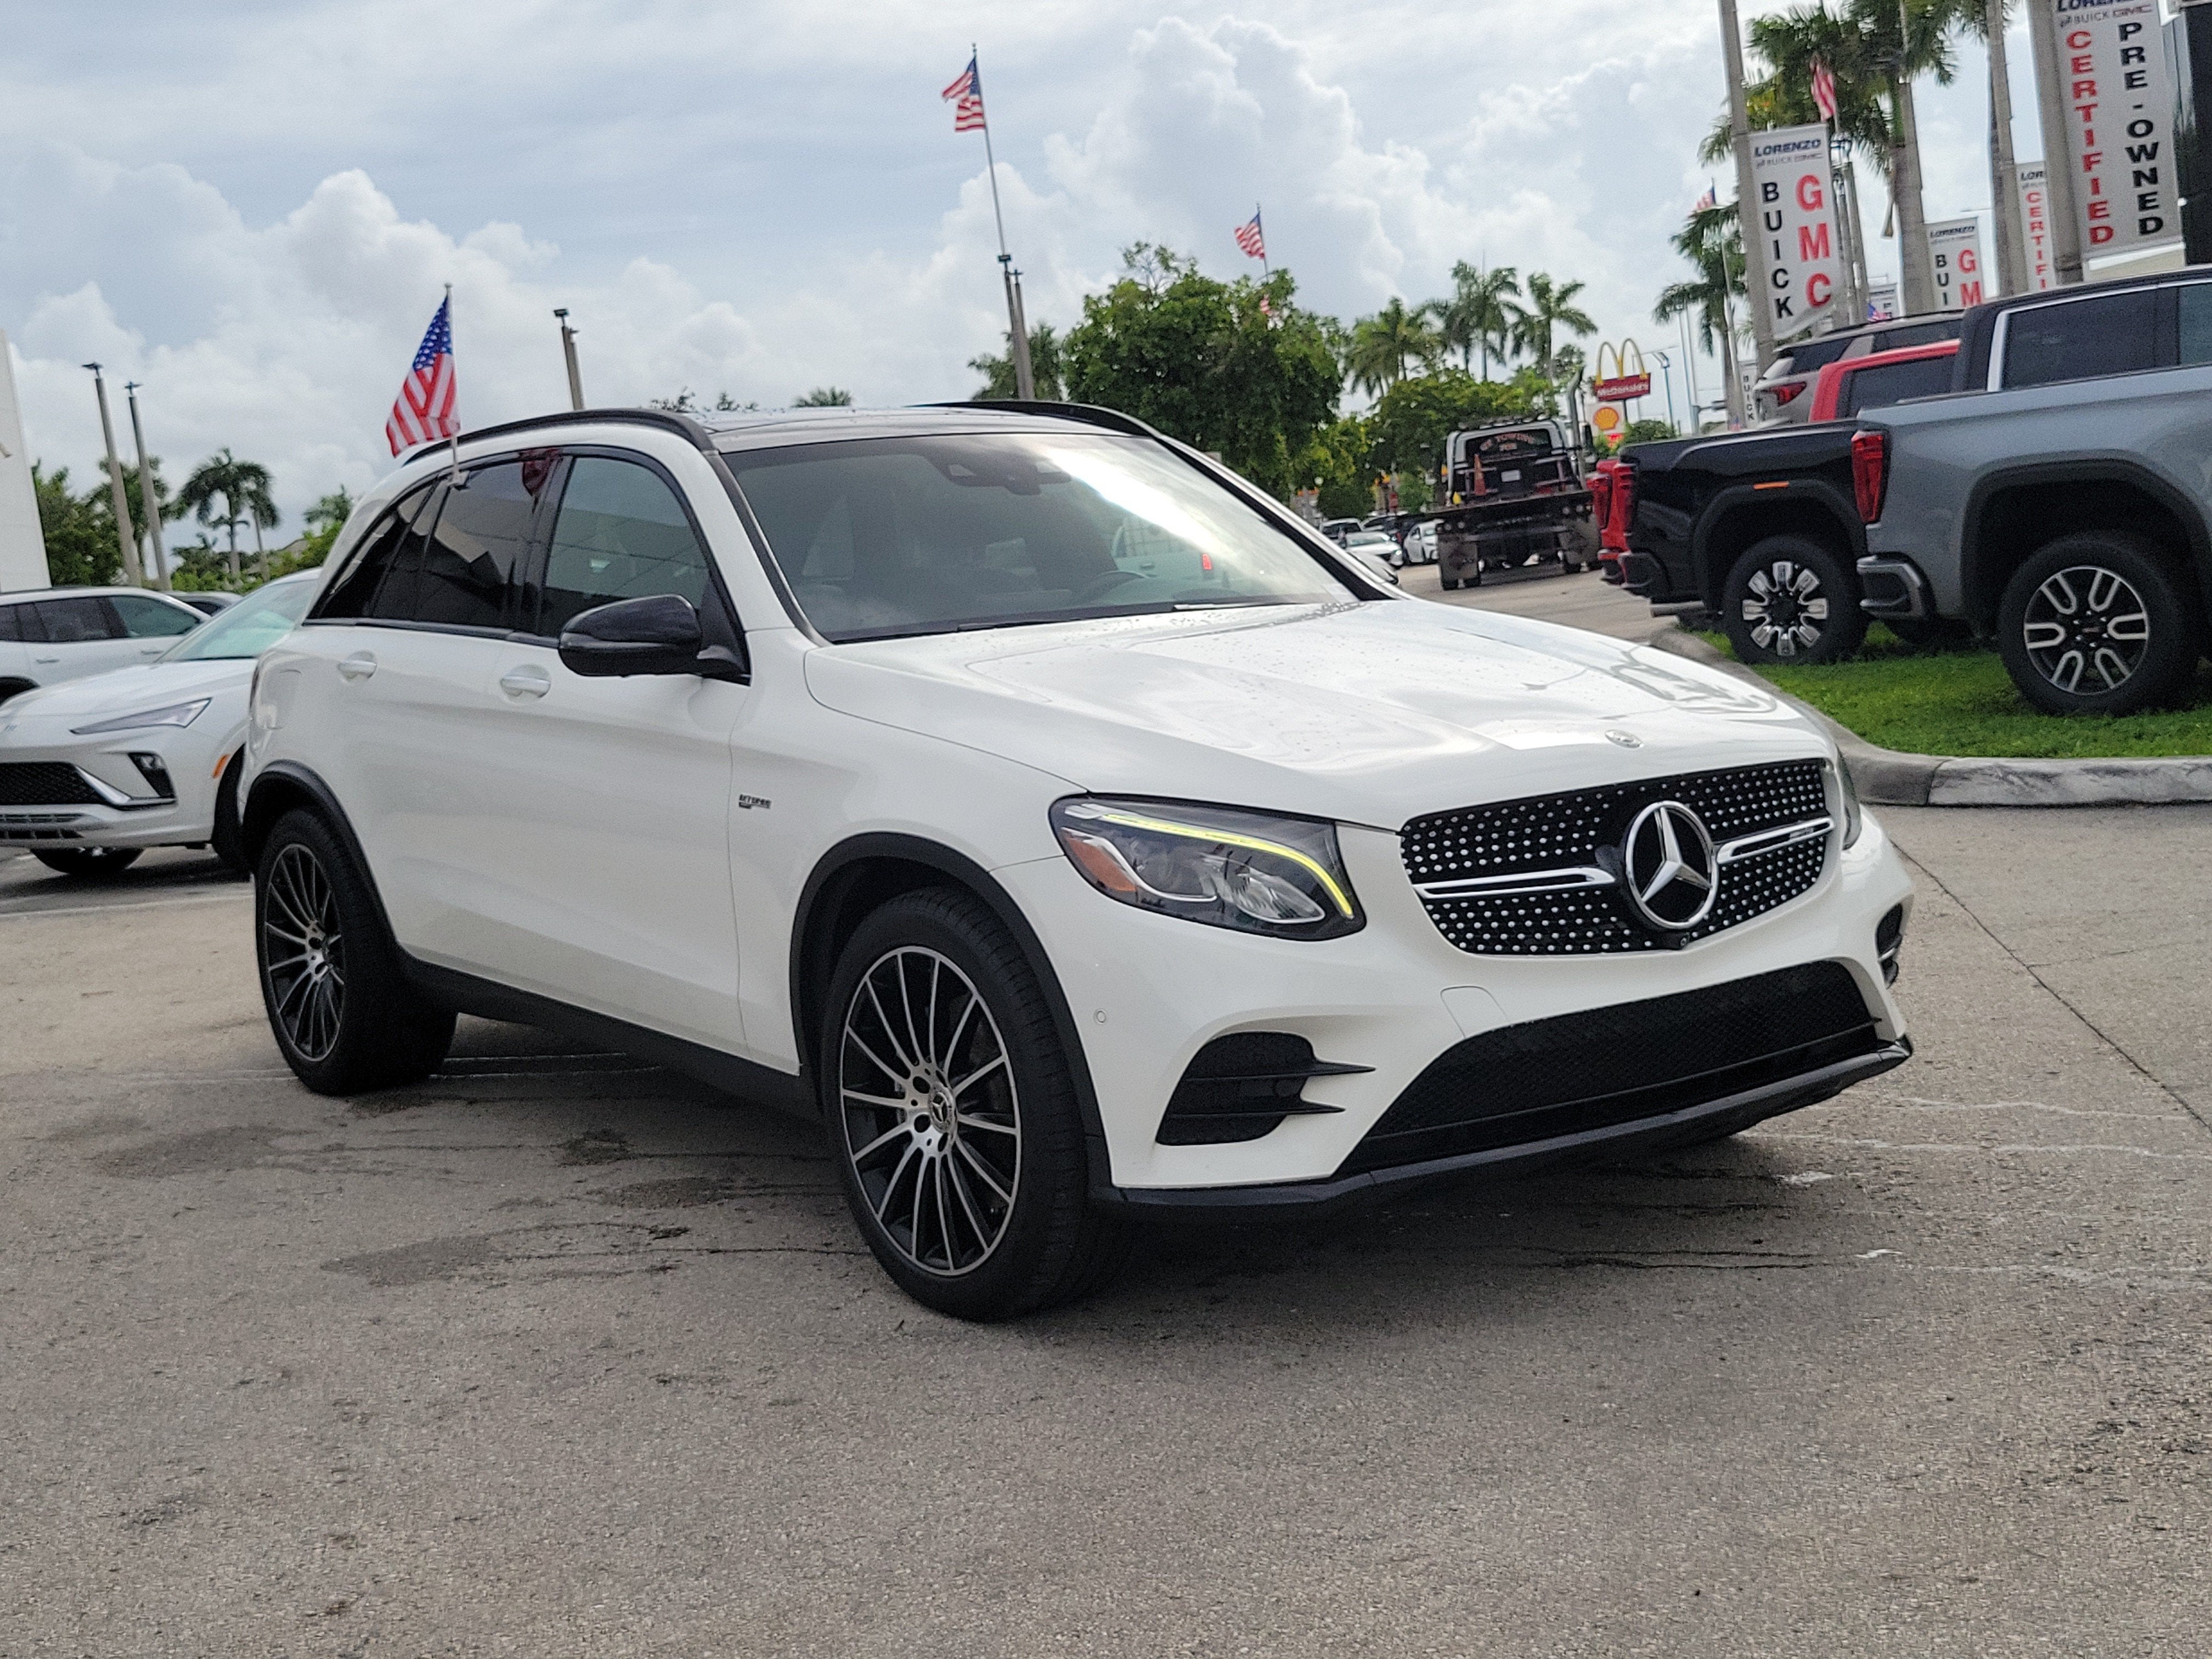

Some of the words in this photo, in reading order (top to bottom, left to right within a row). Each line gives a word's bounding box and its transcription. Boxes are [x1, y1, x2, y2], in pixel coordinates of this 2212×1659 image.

[1755, 138, 1821, 157] LORENZO
[2066, 30, 2114, 245] CERTIFIED
[1762, 182, 1793, 319] BUICK
[1795, 174, 1831, 307] GMC
